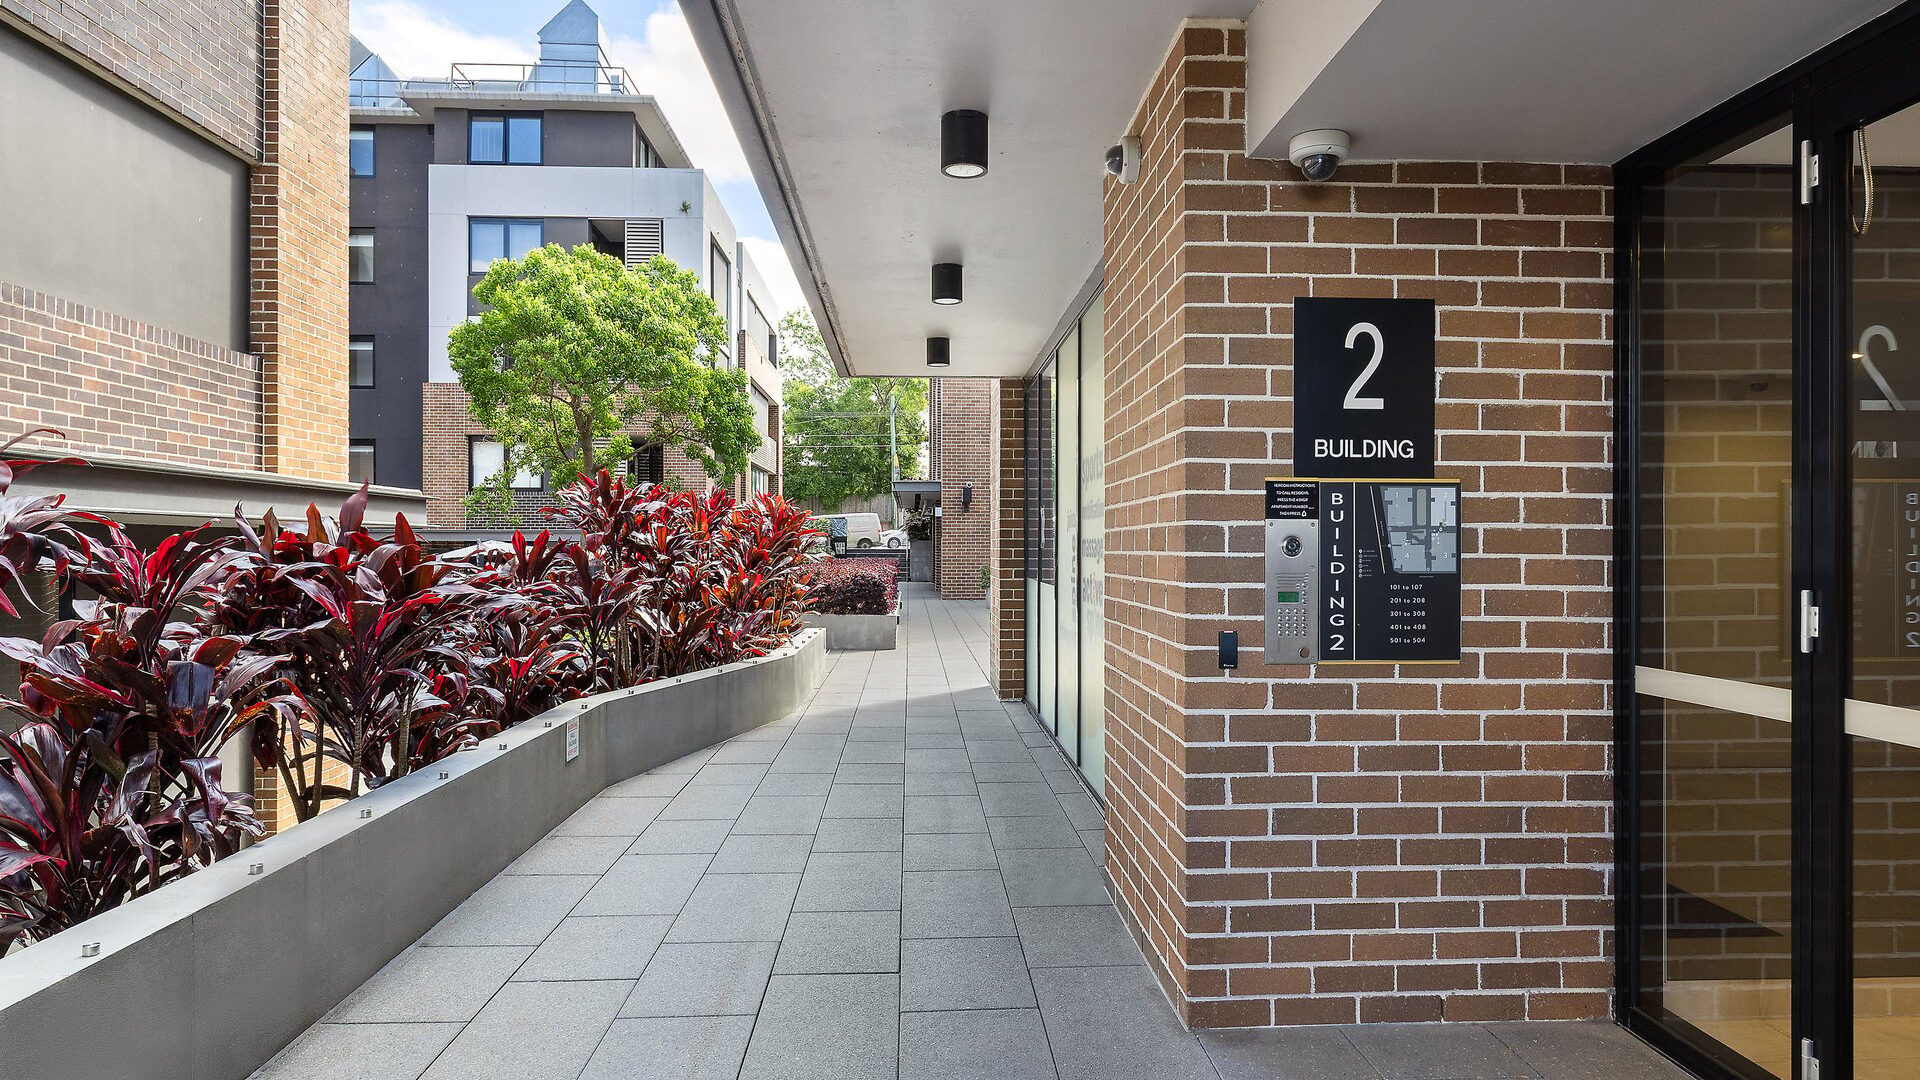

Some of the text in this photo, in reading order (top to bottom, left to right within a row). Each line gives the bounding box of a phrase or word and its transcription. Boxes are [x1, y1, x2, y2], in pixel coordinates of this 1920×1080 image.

[1343, 322, 1385, 409] 2
[1314, 439, 1414, 458] BUILDING
[1329, 493, 1345, 651] BUILDING 2
